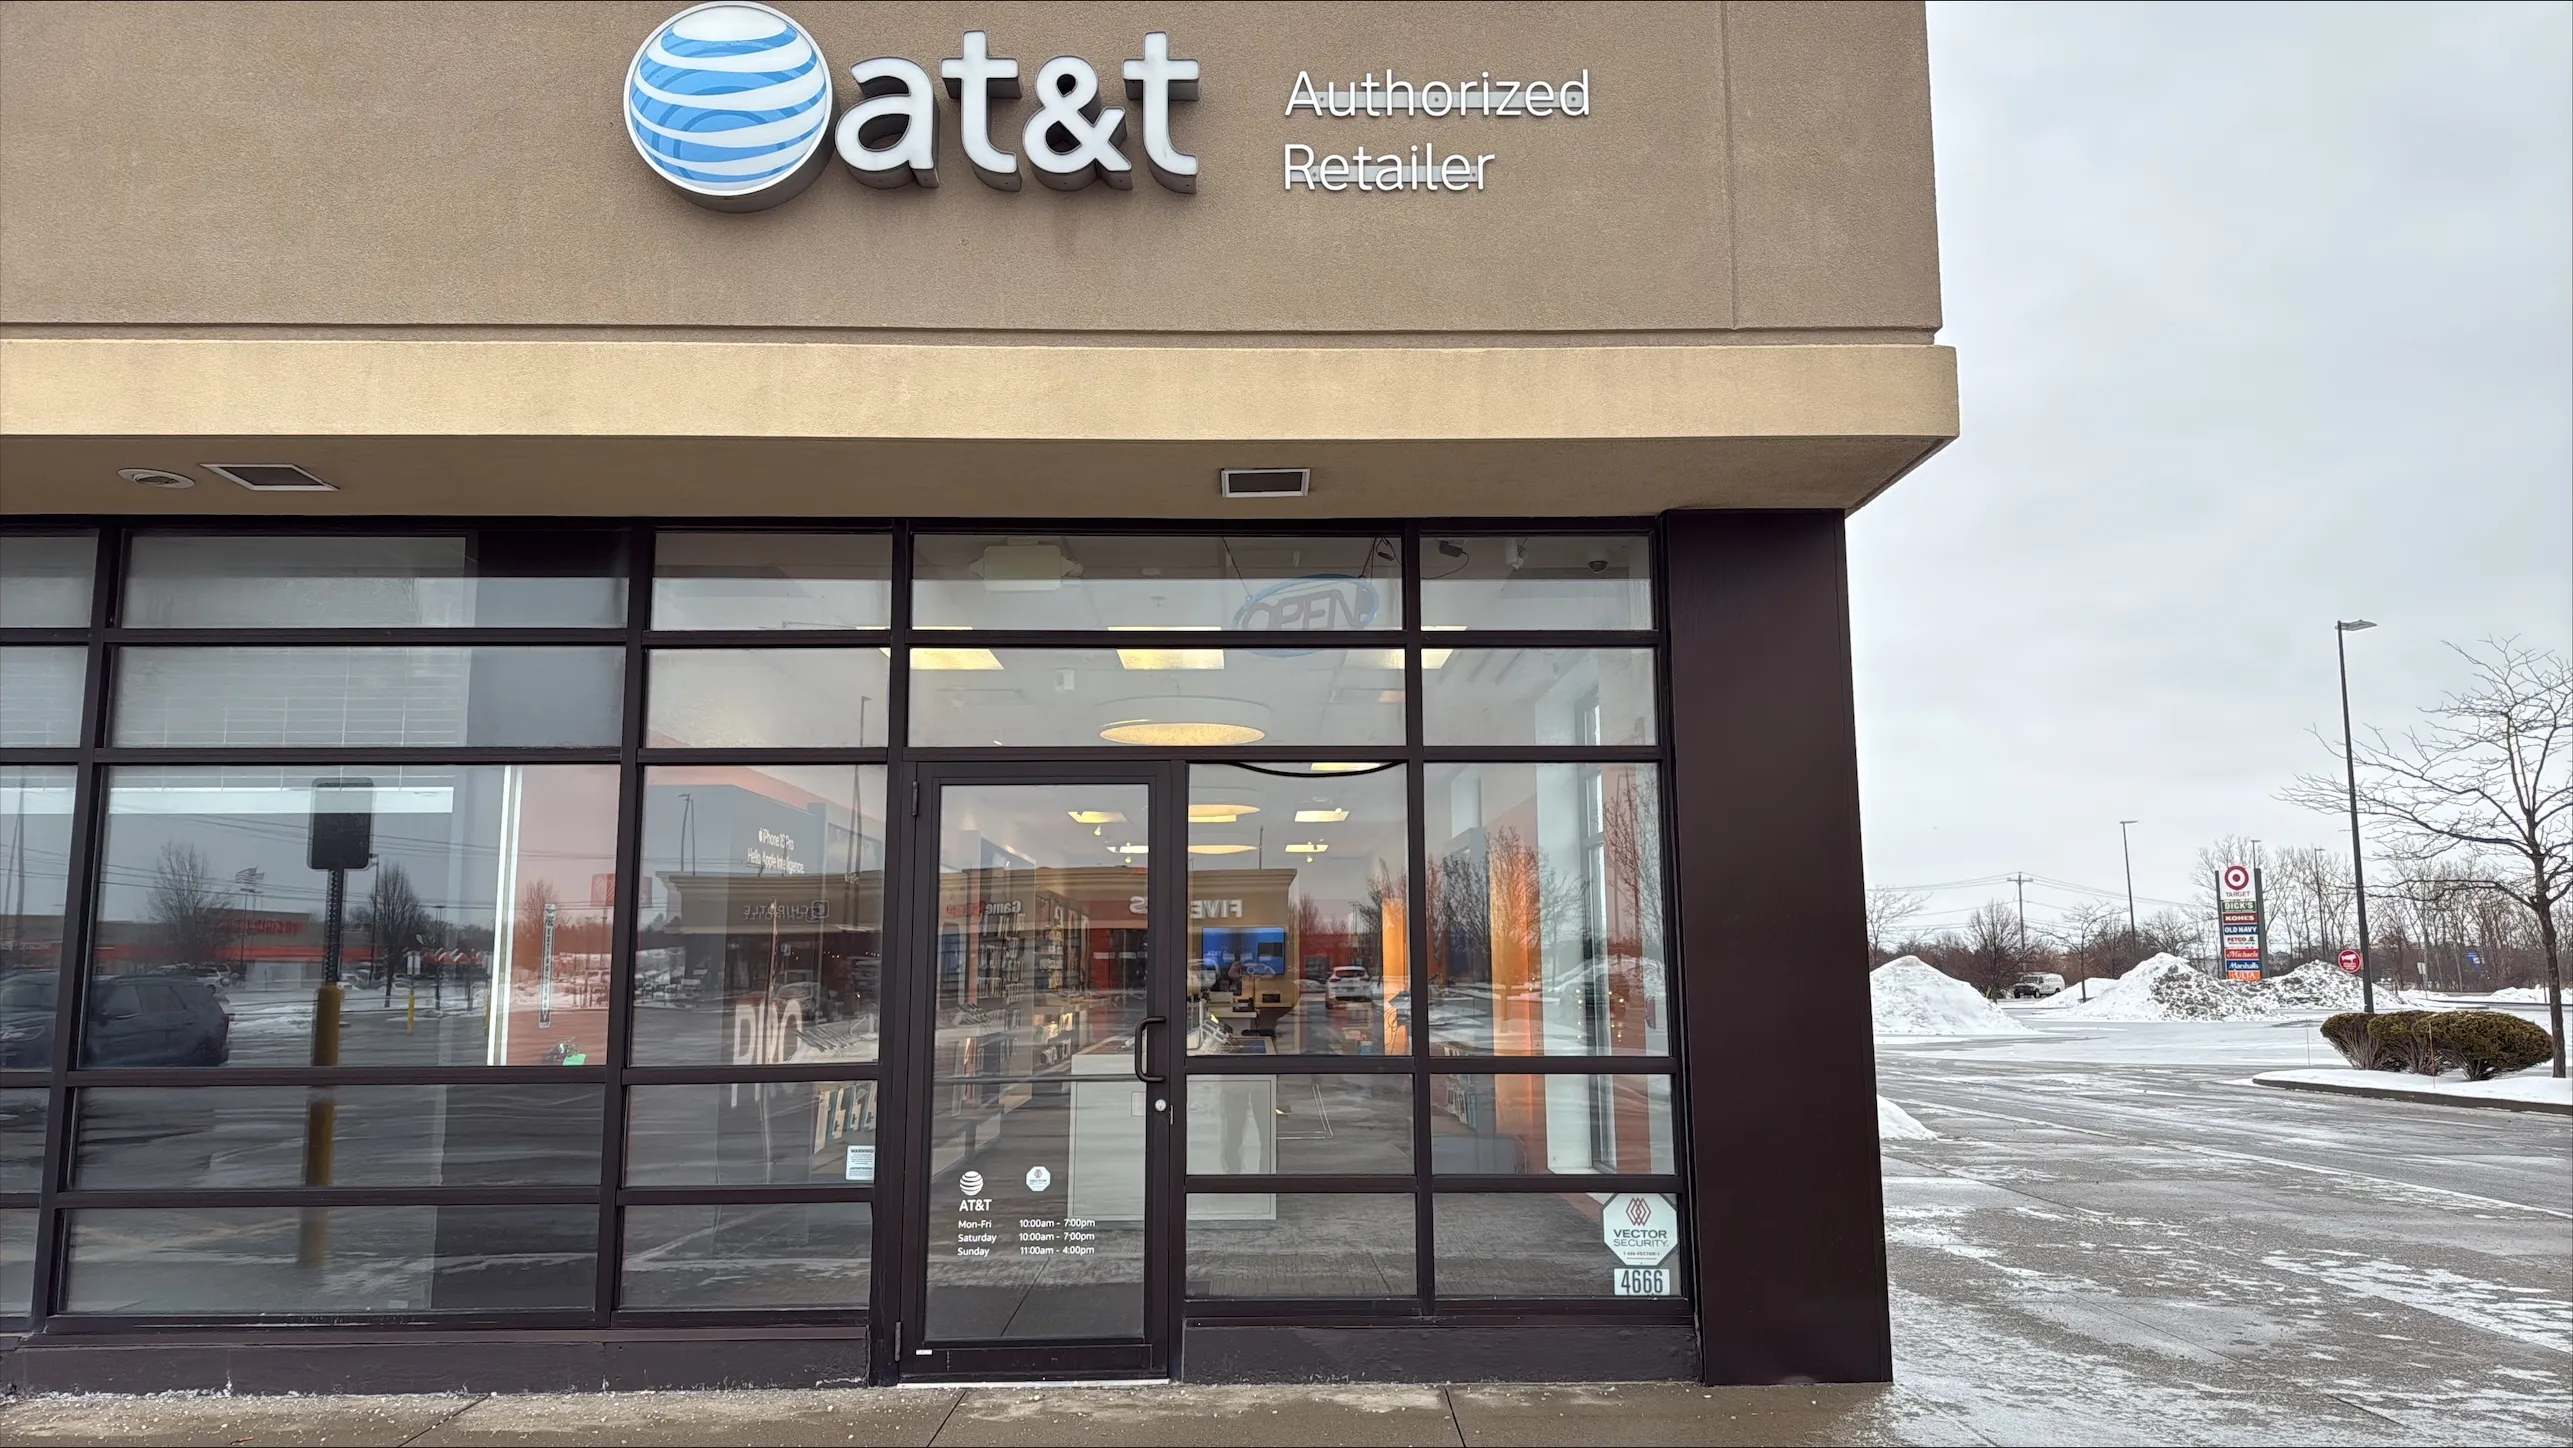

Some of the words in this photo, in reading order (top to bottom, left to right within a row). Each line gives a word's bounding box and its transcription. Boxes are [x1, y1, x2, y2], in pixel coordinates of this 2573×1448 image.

[1284, 68, 1590, 117] Authorized
[834, 29, 1200, 194] at&t
[1284, 142, 1496, 190] Retailer
[1241, 588, 1366, 631] OPEN
[2224, 901, 2254, 910] DICK'S
[2226, 950, 2258, 958] Michaels
[2228, 962, 2259, 970] Marshalls
[959, 1199, 992, 1211] AT&T
[958, 1219, 992, 1229] Mon-Fri
[1019, 1219, 1055, 1227] 10:00am
[1064, 1218, 1095, 1229] 7:00pm
[958, 1233, 997, 1244] Saturday
[1019, 1232, 1055, 1241] 10:00am
[1064, 1232, 1095, 1242] 7:00pm
[1613, 1229, 1667, 1238] VECTOR
[1613, 1239, 1668, 1247] SECURITY
[957, 1247, 990, 1257] Sunday
[1020, 1246, 1054, 1254] 11:00am
[1062, 1245, 1095, 1256] 4:00pm
[1621, 1269, 1663, 1294] 4666
